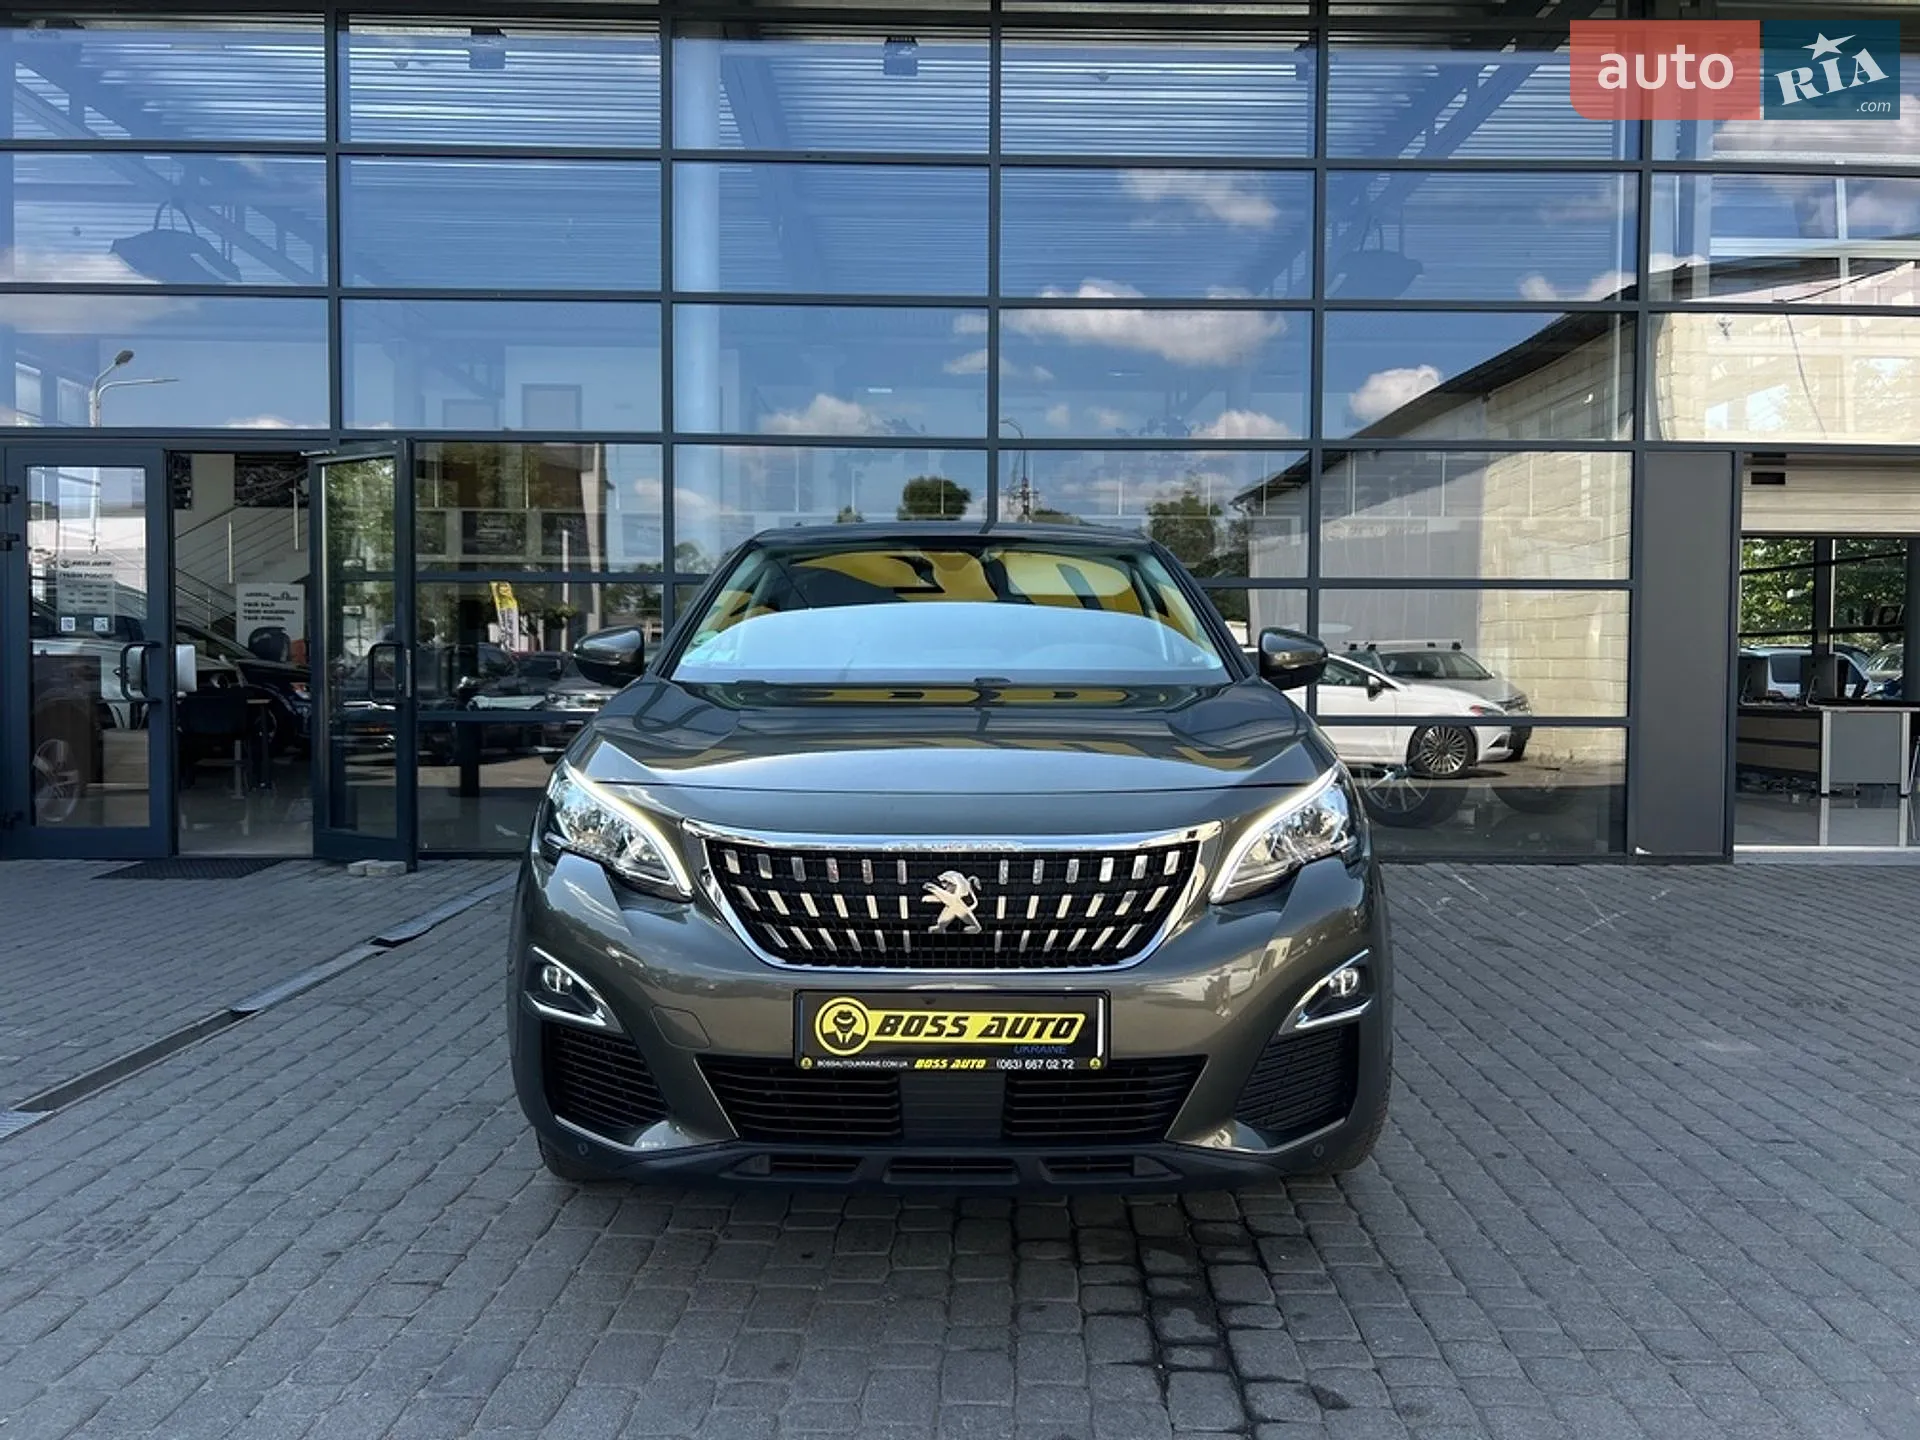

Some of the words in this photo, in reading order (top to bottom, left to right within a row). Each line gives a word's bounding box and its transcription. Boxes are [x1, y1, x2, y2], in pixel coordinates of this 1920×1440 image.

[875, 1014, 969, 1037] BOSS
[978, 1016, 1079, 1039] AUTO
[1014, 1045, 1066, 1055] UKRAINE
[914, 1059, 947, 1069] BOSS
[951, 1059, 986, 1069] AUTO
[1062, 1059, 1075, 1070] 72
